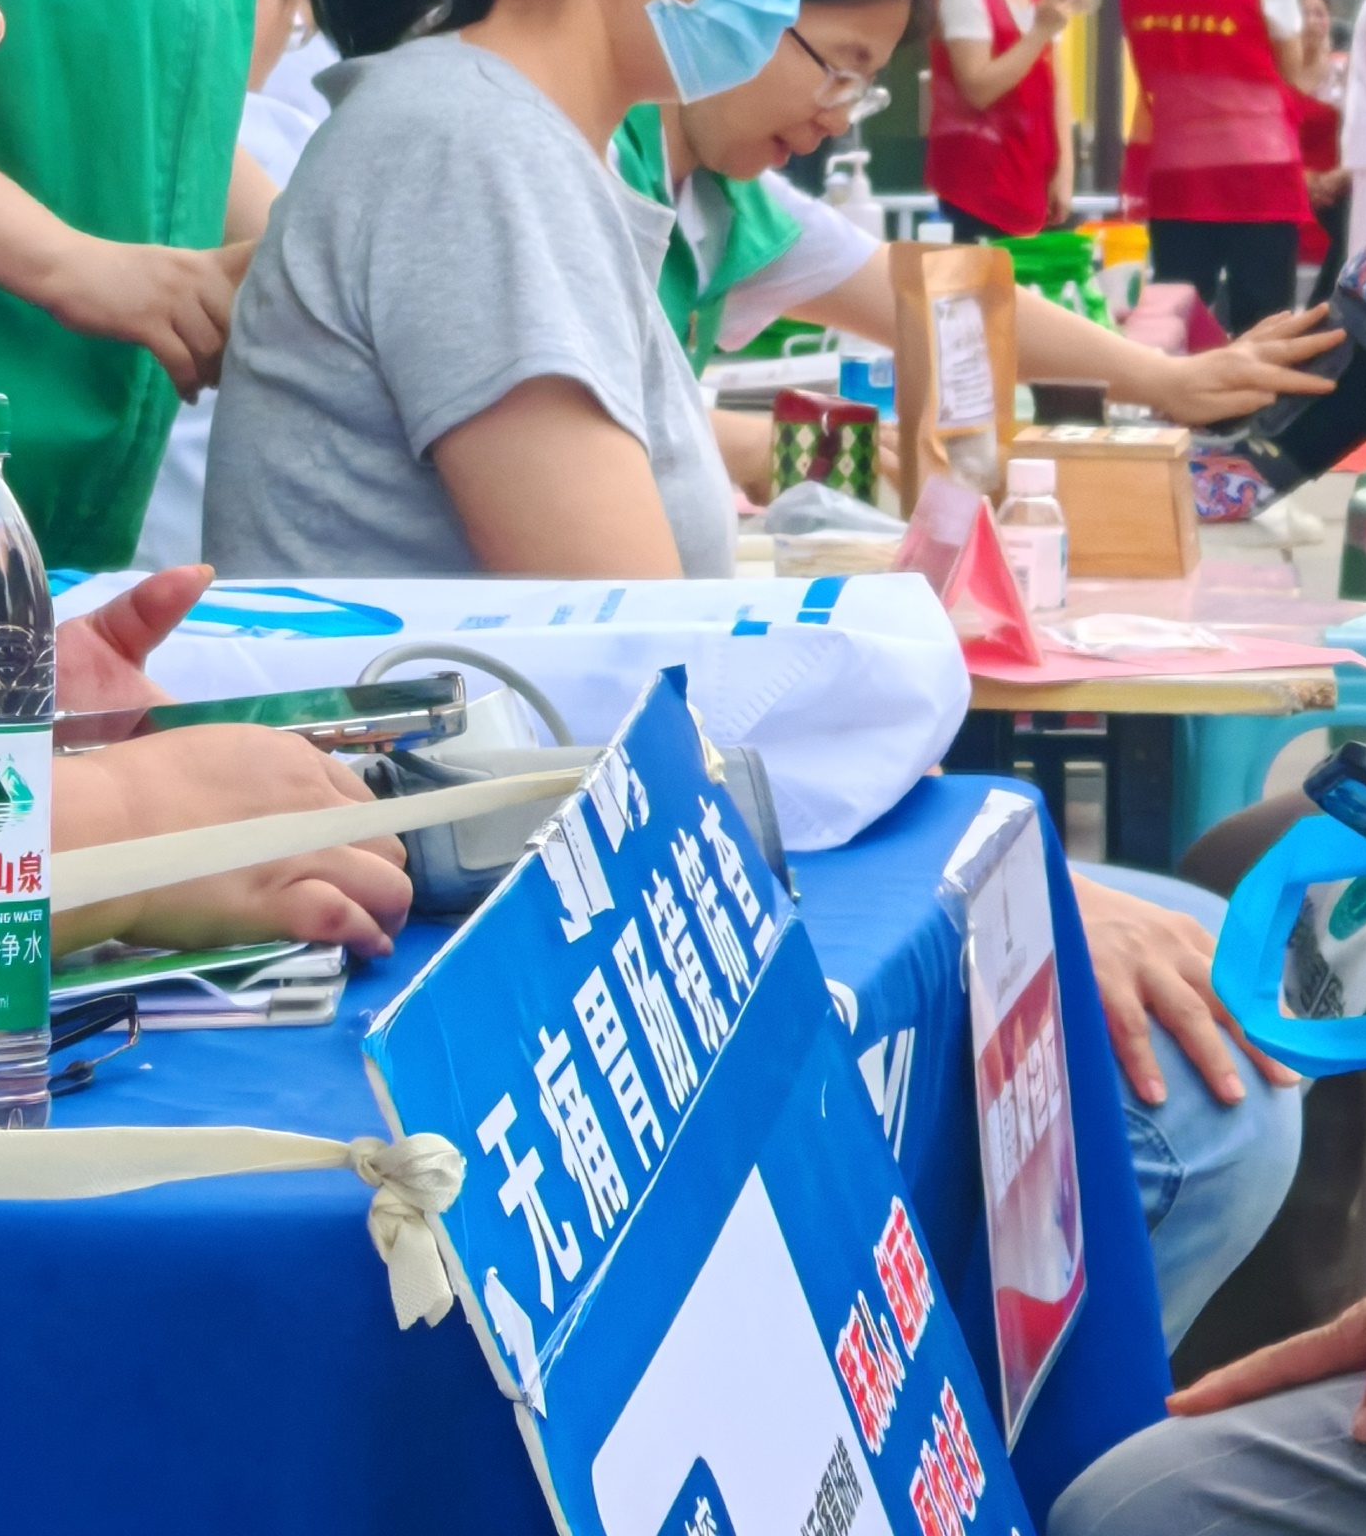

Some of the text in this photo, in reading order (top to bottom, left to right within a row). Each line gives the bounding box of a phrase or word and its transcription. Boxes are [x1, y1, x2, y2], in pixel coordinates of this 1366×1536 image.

[13, 909, 43, 923] WATER
[475, 792, 777, 1316] 无痛胃肠镜筛查
